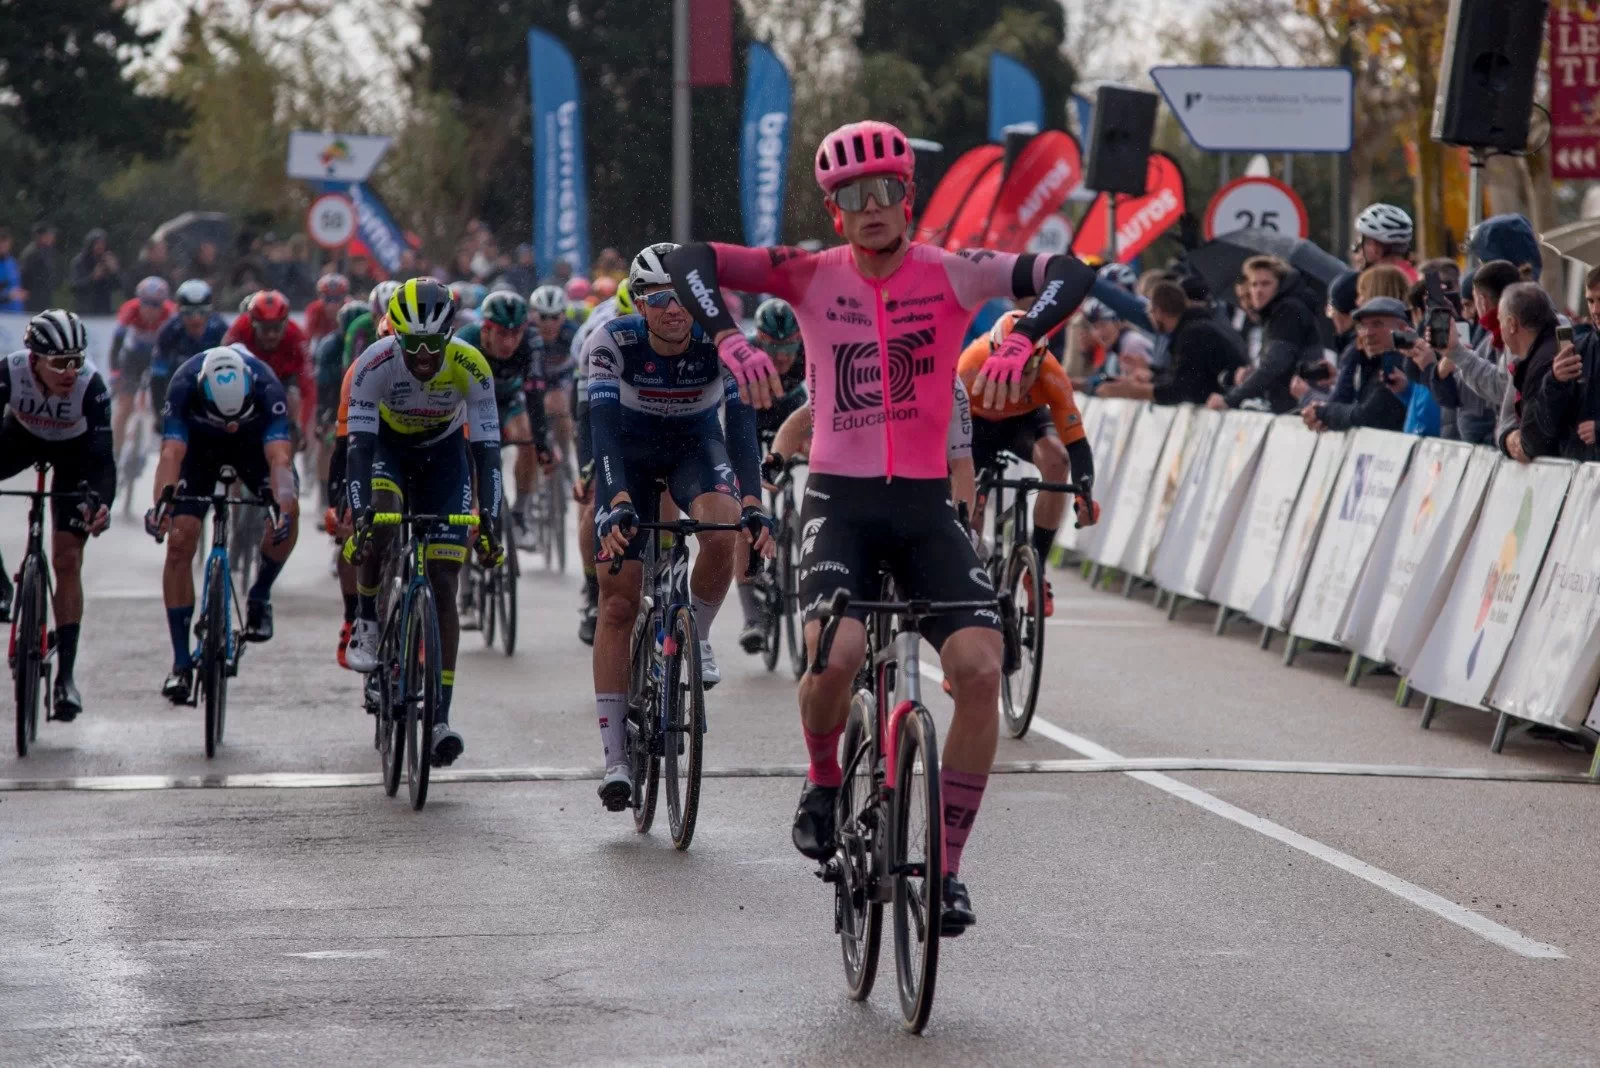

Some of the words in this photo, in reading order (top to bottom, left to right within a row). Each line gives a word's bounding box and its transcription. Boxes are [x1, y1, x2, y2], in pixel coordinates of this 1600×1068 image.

[1018, 157, 1072, 226] AUTOS
[1234, 209, 1280, 233] 25
[685, 269, 720, 318] wahoo
[900, 293, 945, 308] easypost
[1025, 280, 1065, 319] wahoo
[840, 314, 873, 327] NIPPO
[891, 312, 934, 324] wahoo
[453, 351, 491, 391] Wallonie
[633, 374, 664, 384] Ekopak
[19, 398, 72, 419] UAE
[832, 406, 919, 432] Education
[350, 480, 362, 509] Circus
